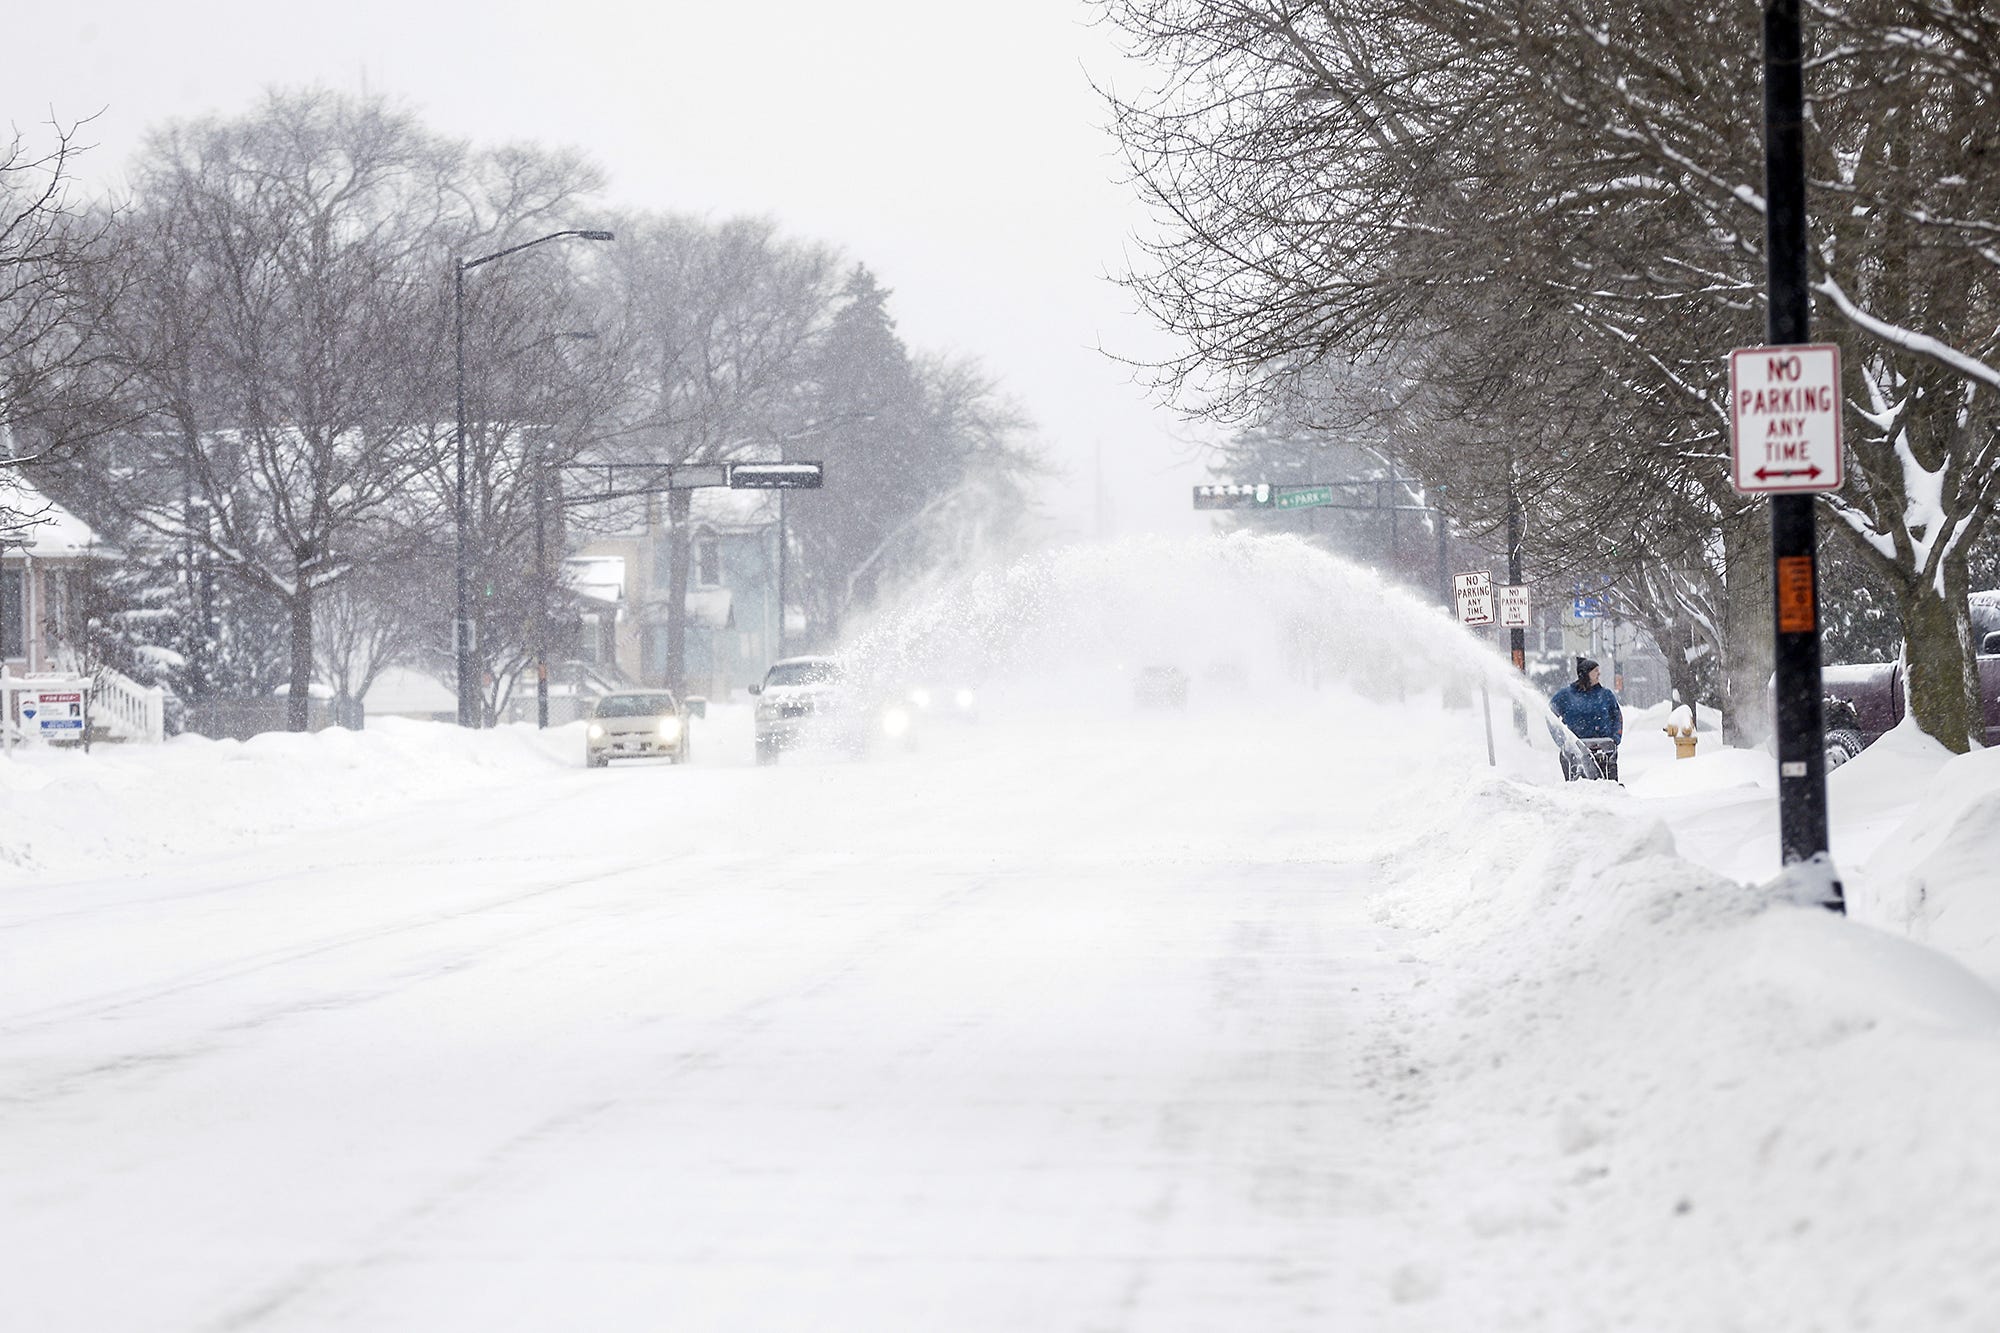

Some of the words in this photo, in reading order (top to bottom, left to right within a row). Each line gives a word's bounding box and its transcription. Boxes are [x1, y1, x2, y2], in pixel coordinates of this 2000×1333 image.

[1767, 355, 1801, 382] NO
[1740, 385, 1831, 415] PARKING
[1766, 418, 1806, 437] ANY
[1765, 441, 1810, 462] TIME
[1295, 493, 1320, 506] PARK
[1466, 575, 1478, 586] NO
[1457, 586, 1490, 599] PARKING
[1468, 607, 1483, 615] TIME
